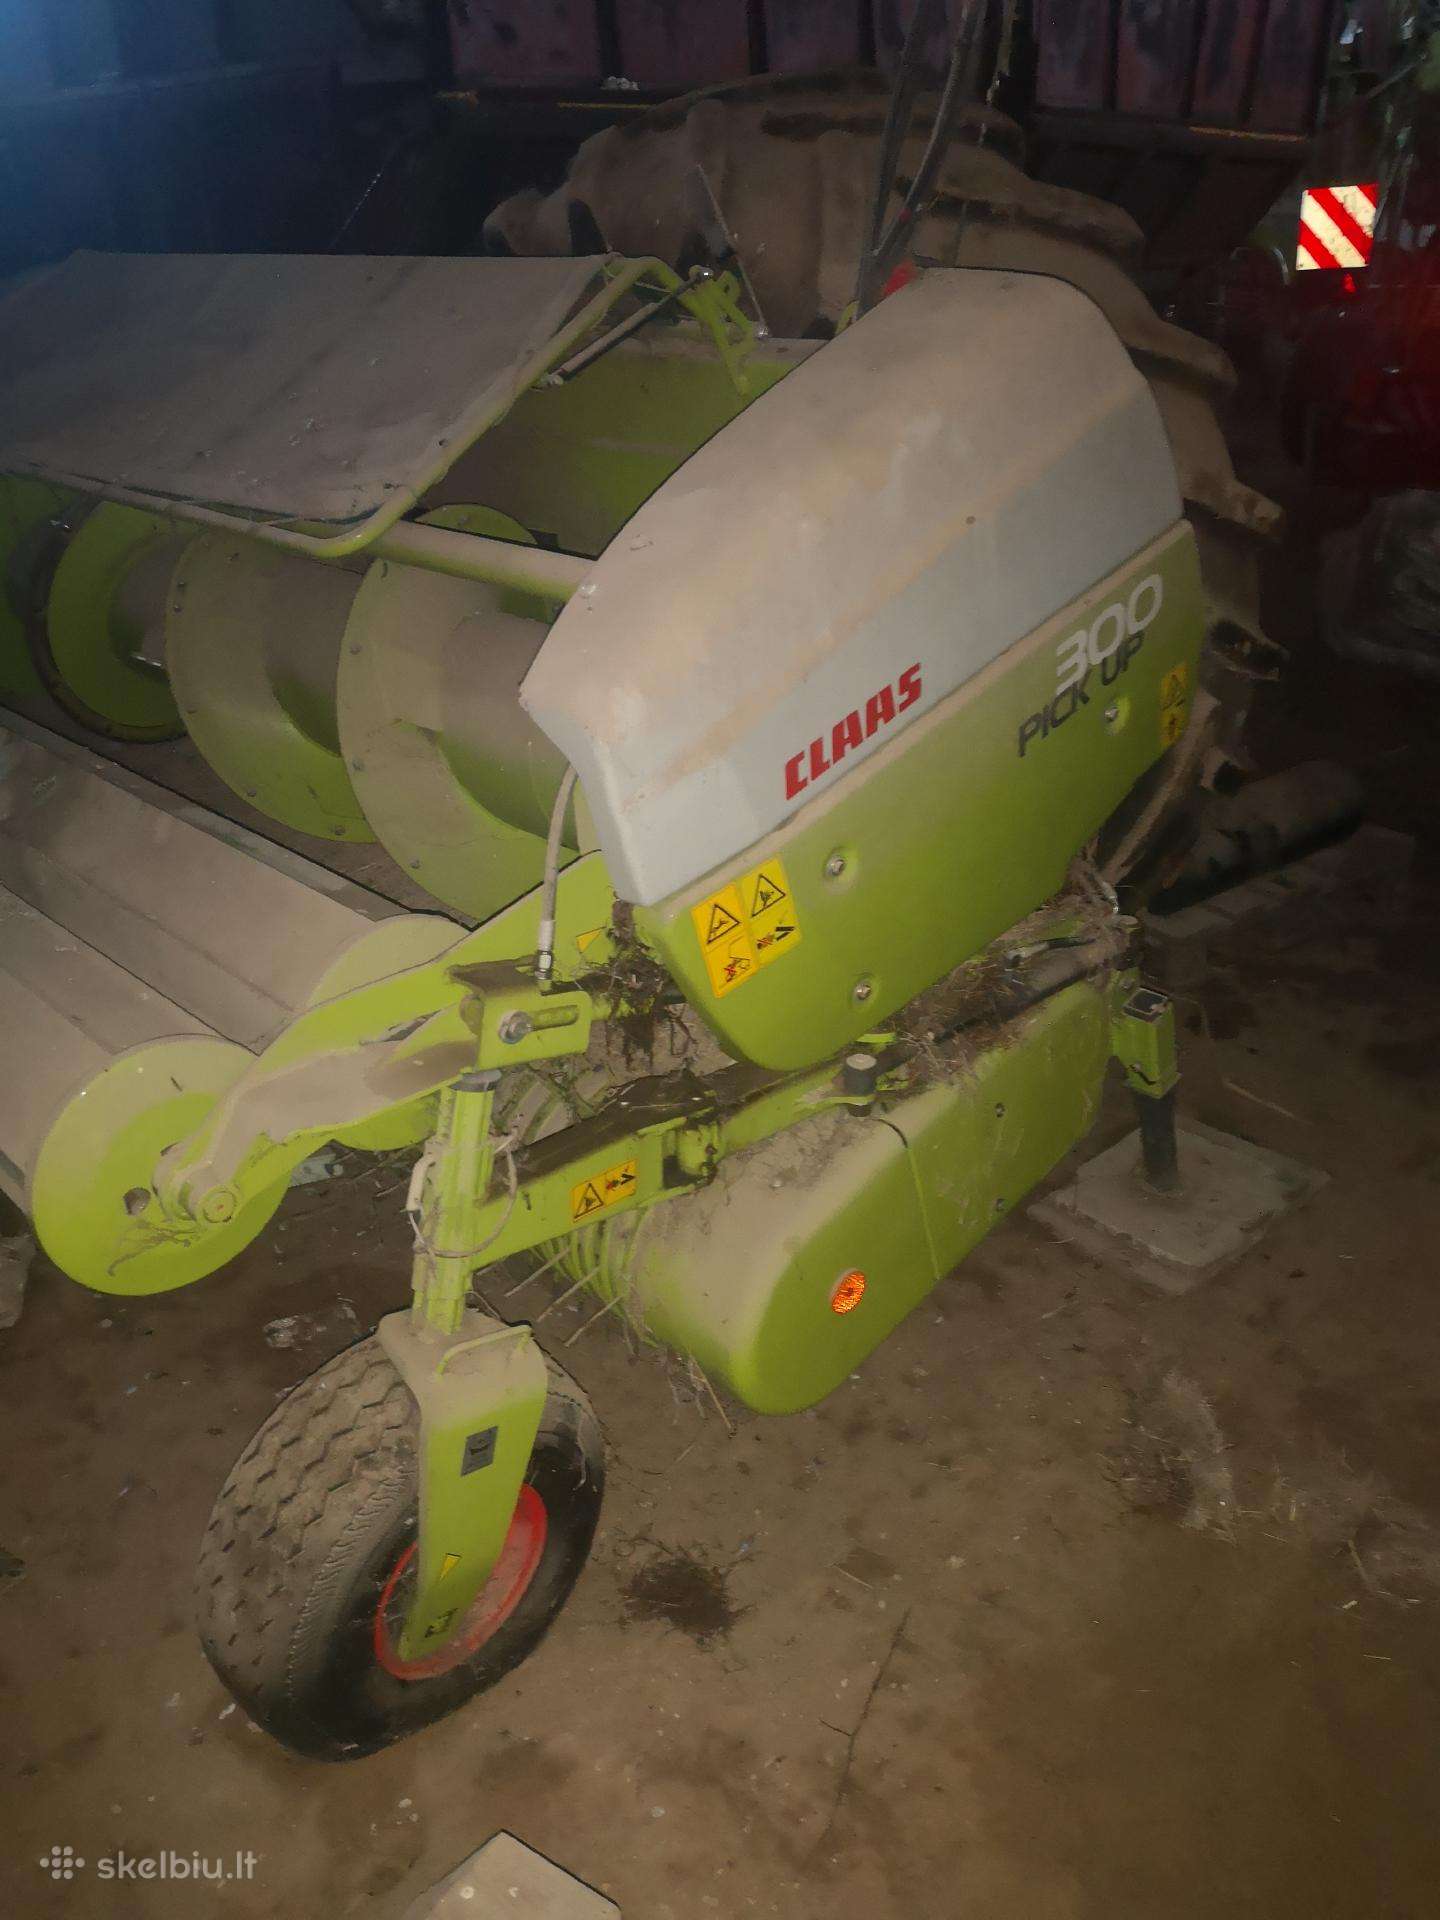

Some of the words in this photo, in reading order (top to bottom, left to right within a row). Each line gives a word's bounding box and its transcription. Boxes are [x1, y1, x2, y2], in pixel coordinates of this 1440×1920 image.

[1018, 672, 1090, 757] PICK
[1101, 631, 1145, 686] UP
[1056, 574, 1163, 697] 300
[785, 662, 922, 800] CLAAS
